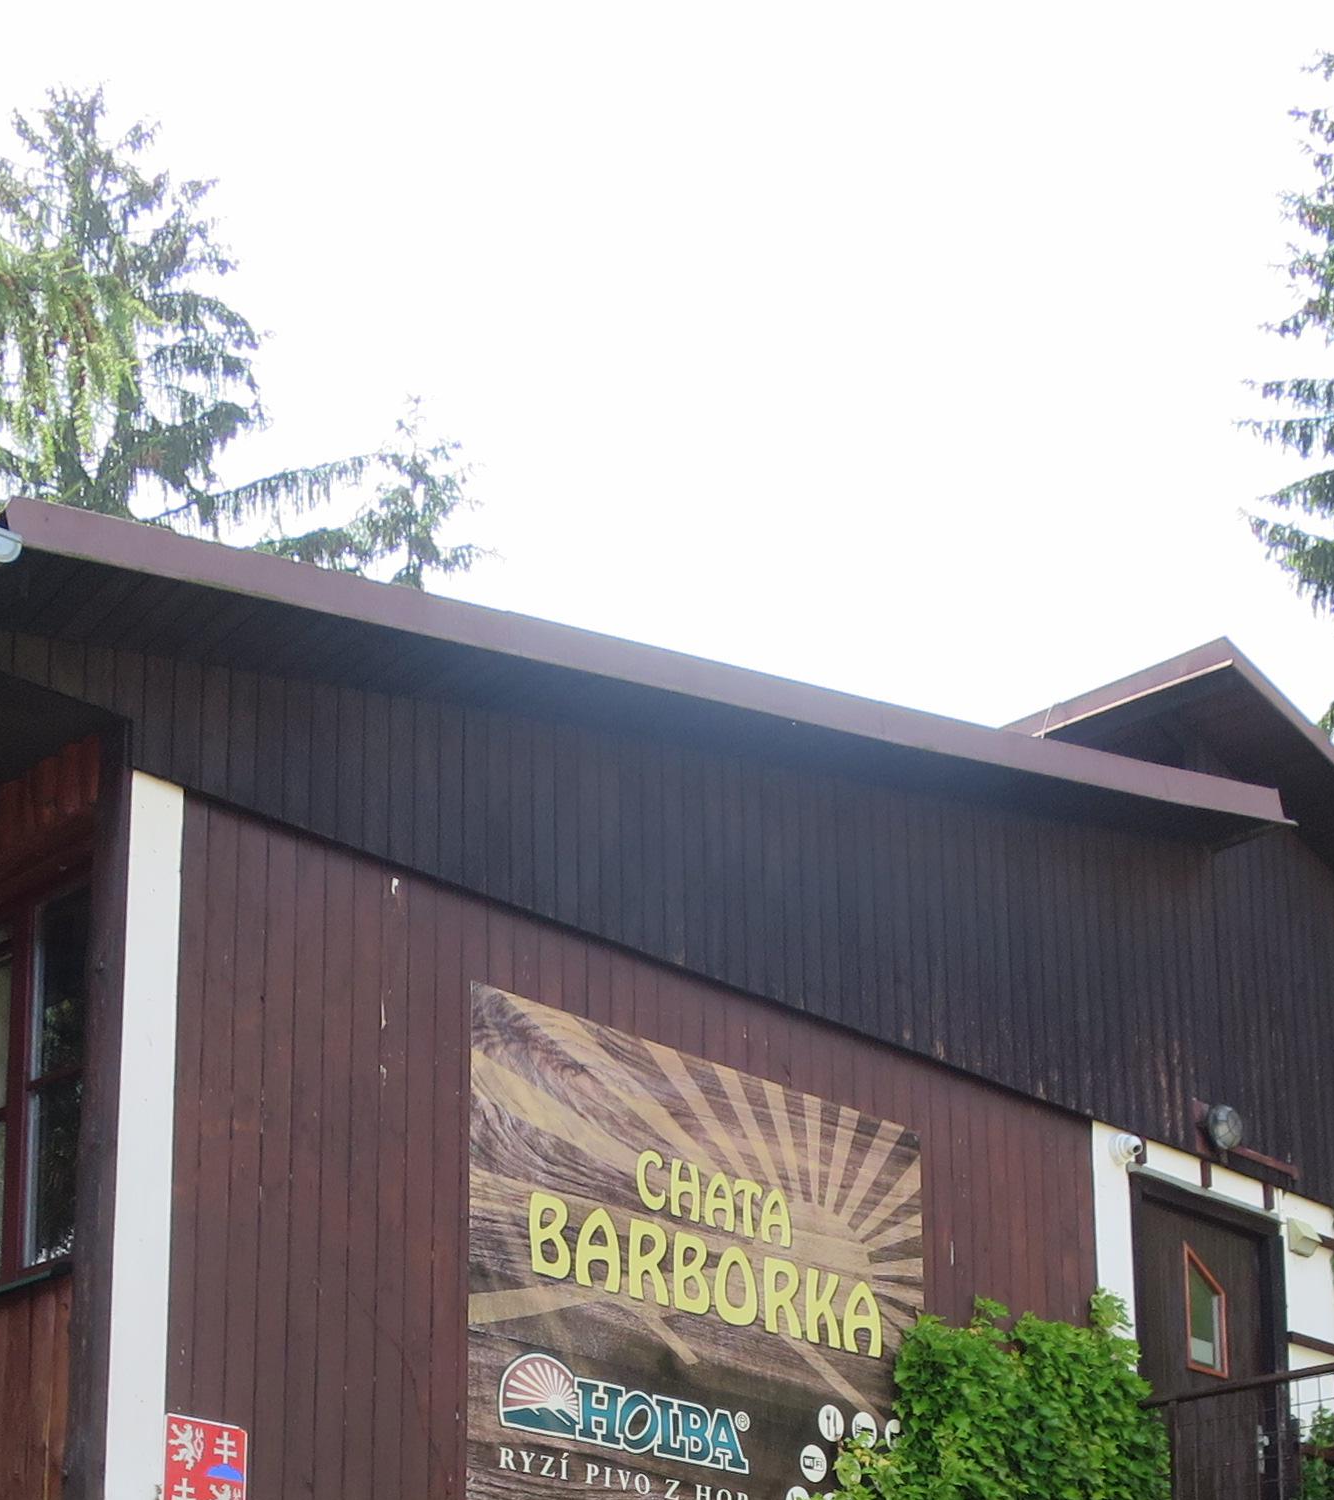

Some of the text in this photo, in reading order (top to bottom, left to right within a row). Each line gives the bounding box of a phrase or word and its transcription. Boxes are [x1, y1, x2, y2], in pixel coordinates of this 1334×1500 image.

[636, 1150, 791, 1248] CHATA
[528, 1191, 883, 1358] BARBORKA
[498, 1446, 570, 1481] RYZÍ
[585, 1463, 652, 1496] PIVO
